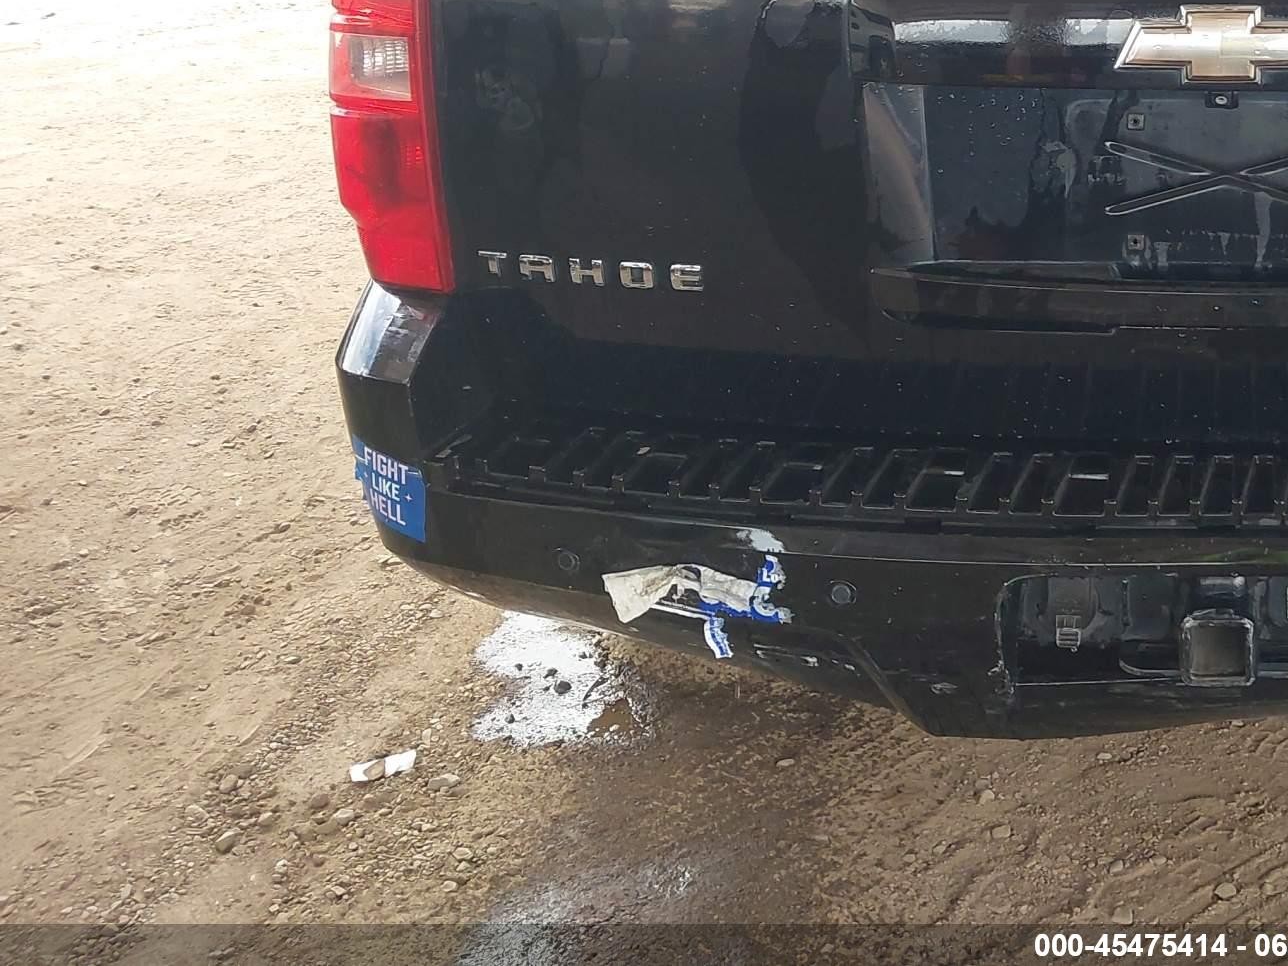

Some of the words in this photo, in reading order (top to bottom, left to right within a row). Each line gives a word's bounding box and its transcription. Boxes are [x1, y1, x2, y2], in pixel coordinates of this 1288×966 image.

[477, 250, 704, 291] TAHOE
[364, 446, 409, 485] FIGHT
[371, 472, 401, 501] LIKE
[370, 488, 407, 526] HELL
